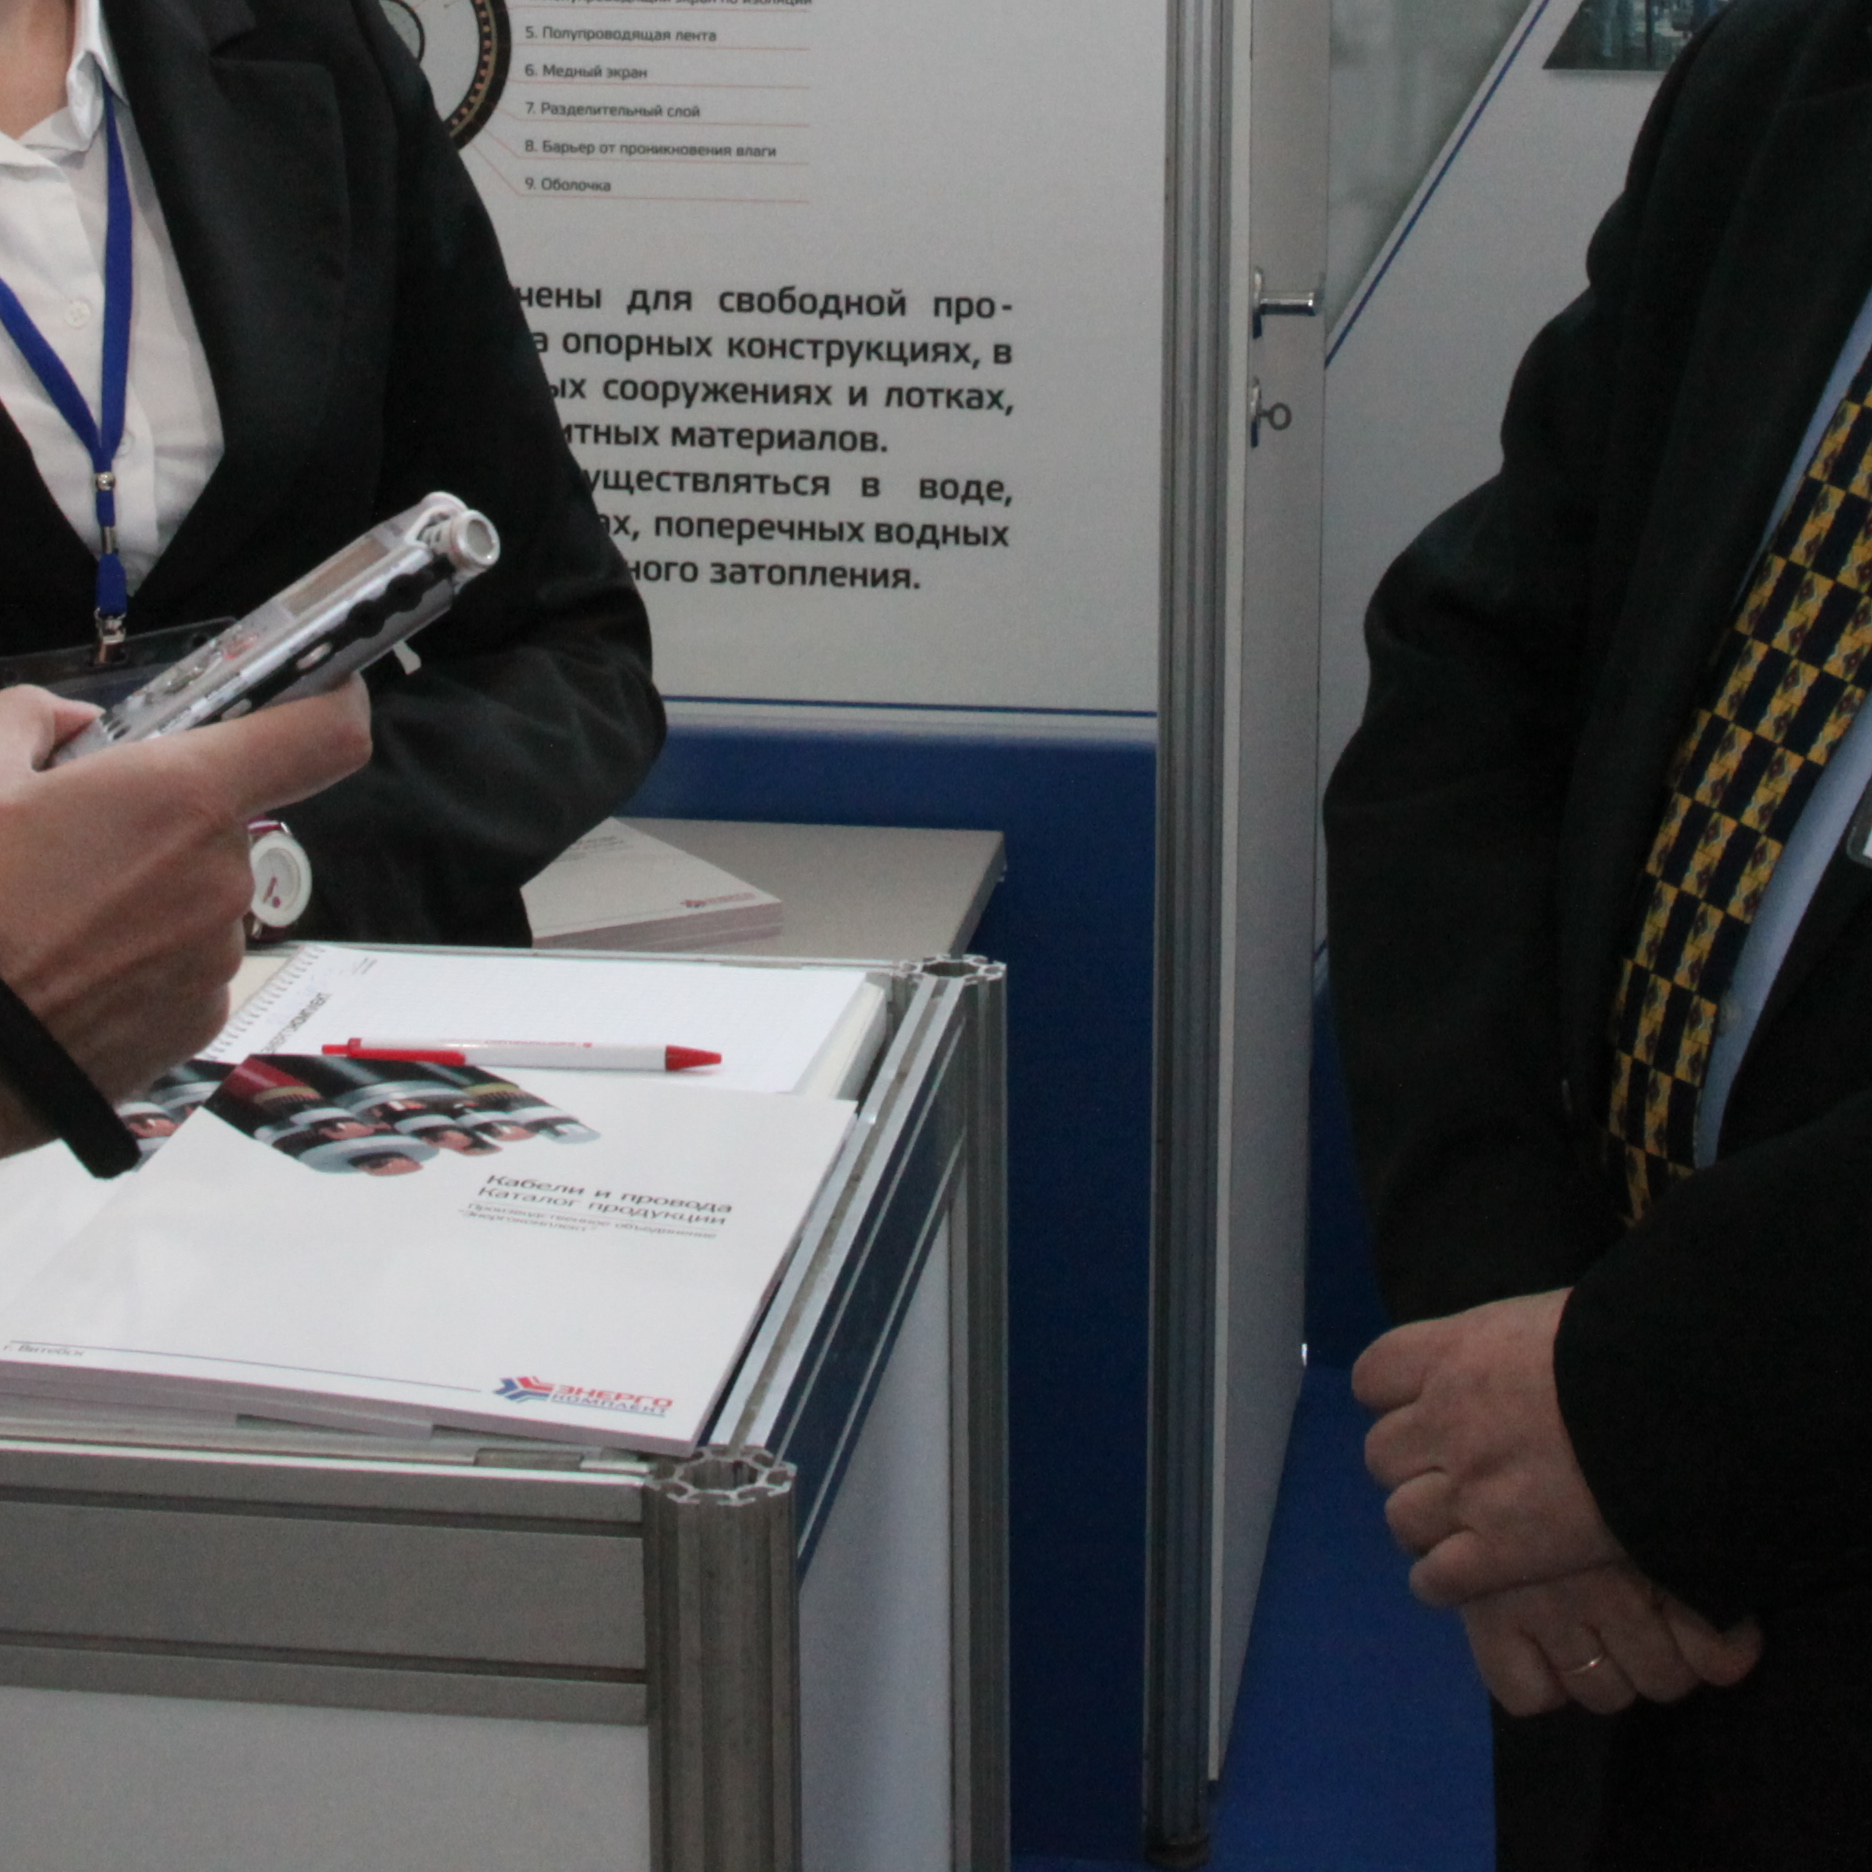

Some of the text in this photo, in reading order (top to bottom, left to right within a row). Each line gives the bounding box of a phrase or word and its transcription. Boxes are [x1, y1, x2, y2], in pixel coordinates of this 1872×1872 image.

[525, 25, 717, 43] 5. Полупроводящая лента
[524, 63, 648, 81] 6. Медный экран
[525, 101, 701, 118] 7. Разделительный слой
[524, 138, 777, 158] 8. Барьер от проникновения влаги
[524, 176, 612, 193] 9. Оболочка
[515, 285, 1012, 325] нены для свободной про-
[533, 331, 1012, 370] а опорных конструкциях, в
[549, 378, 1014, 417] ых сооружениях и лотках,
[564, 423, 888, 456] тных материалов.
[583, 468, 1013, 508] уществляться в воде,
[654, 516, 865, 547] поперечных
[874, 522, 1009, 550] водных
[629, 560, 920, 590] ного затопления.
[486, 1174, 586, 1196] Кабели
[554, 1384, 674, 1410] ЭНЕРГО
